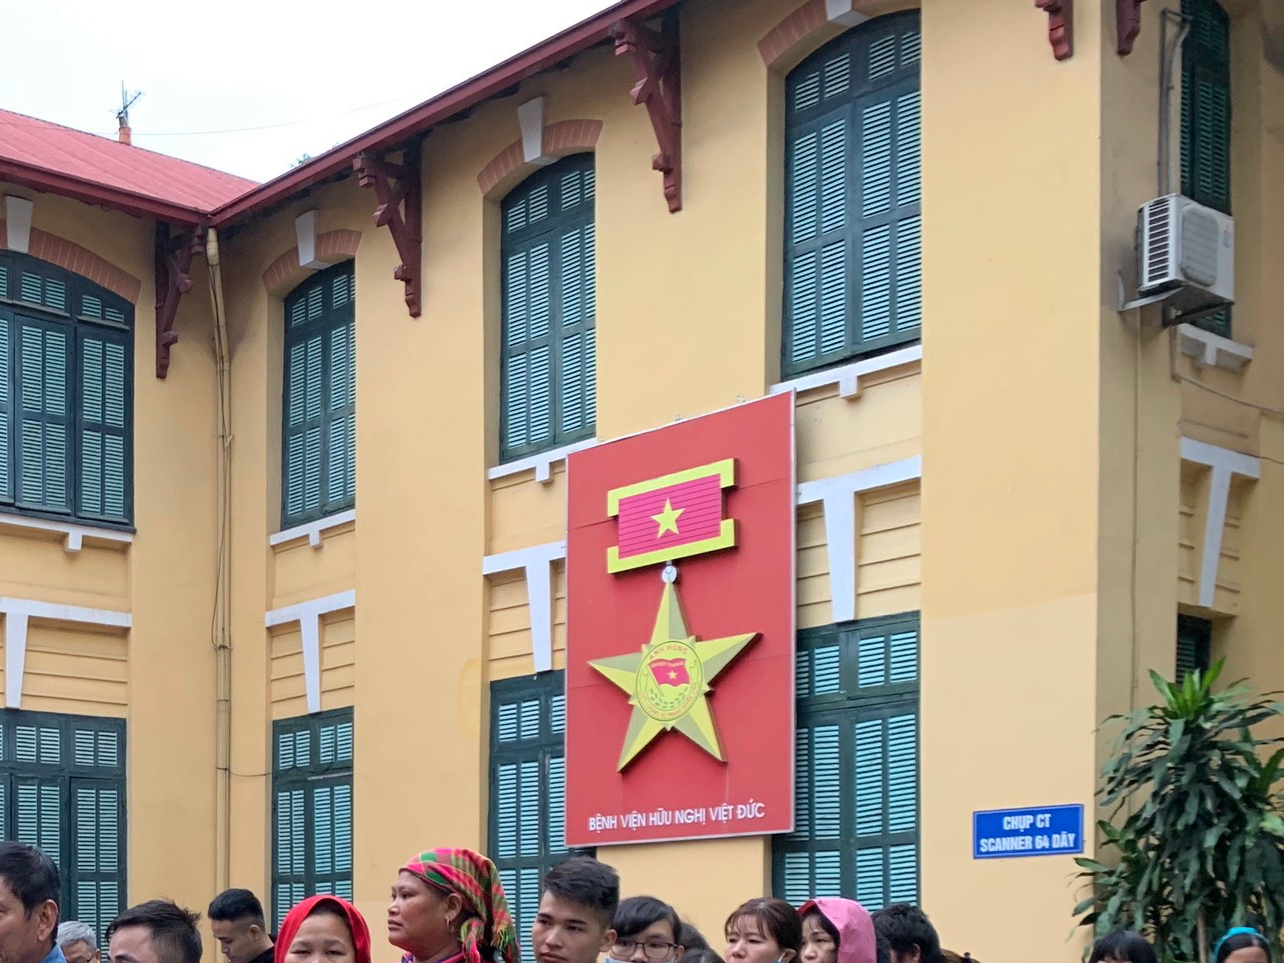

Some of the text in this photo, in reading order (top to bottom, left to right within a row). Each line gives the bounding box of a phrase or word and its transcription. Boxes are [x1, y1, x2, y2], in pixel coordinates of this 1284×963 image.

[589, 798, 765, 833] BỆNH VIỆN HỮU NGHỊ VIỆT ĐỨC
[1002, 813, 1052, 832] CHỤP CT
[979, 835, 1033, 852] SCANNER
[1035, 835, 1050, 849] 64
